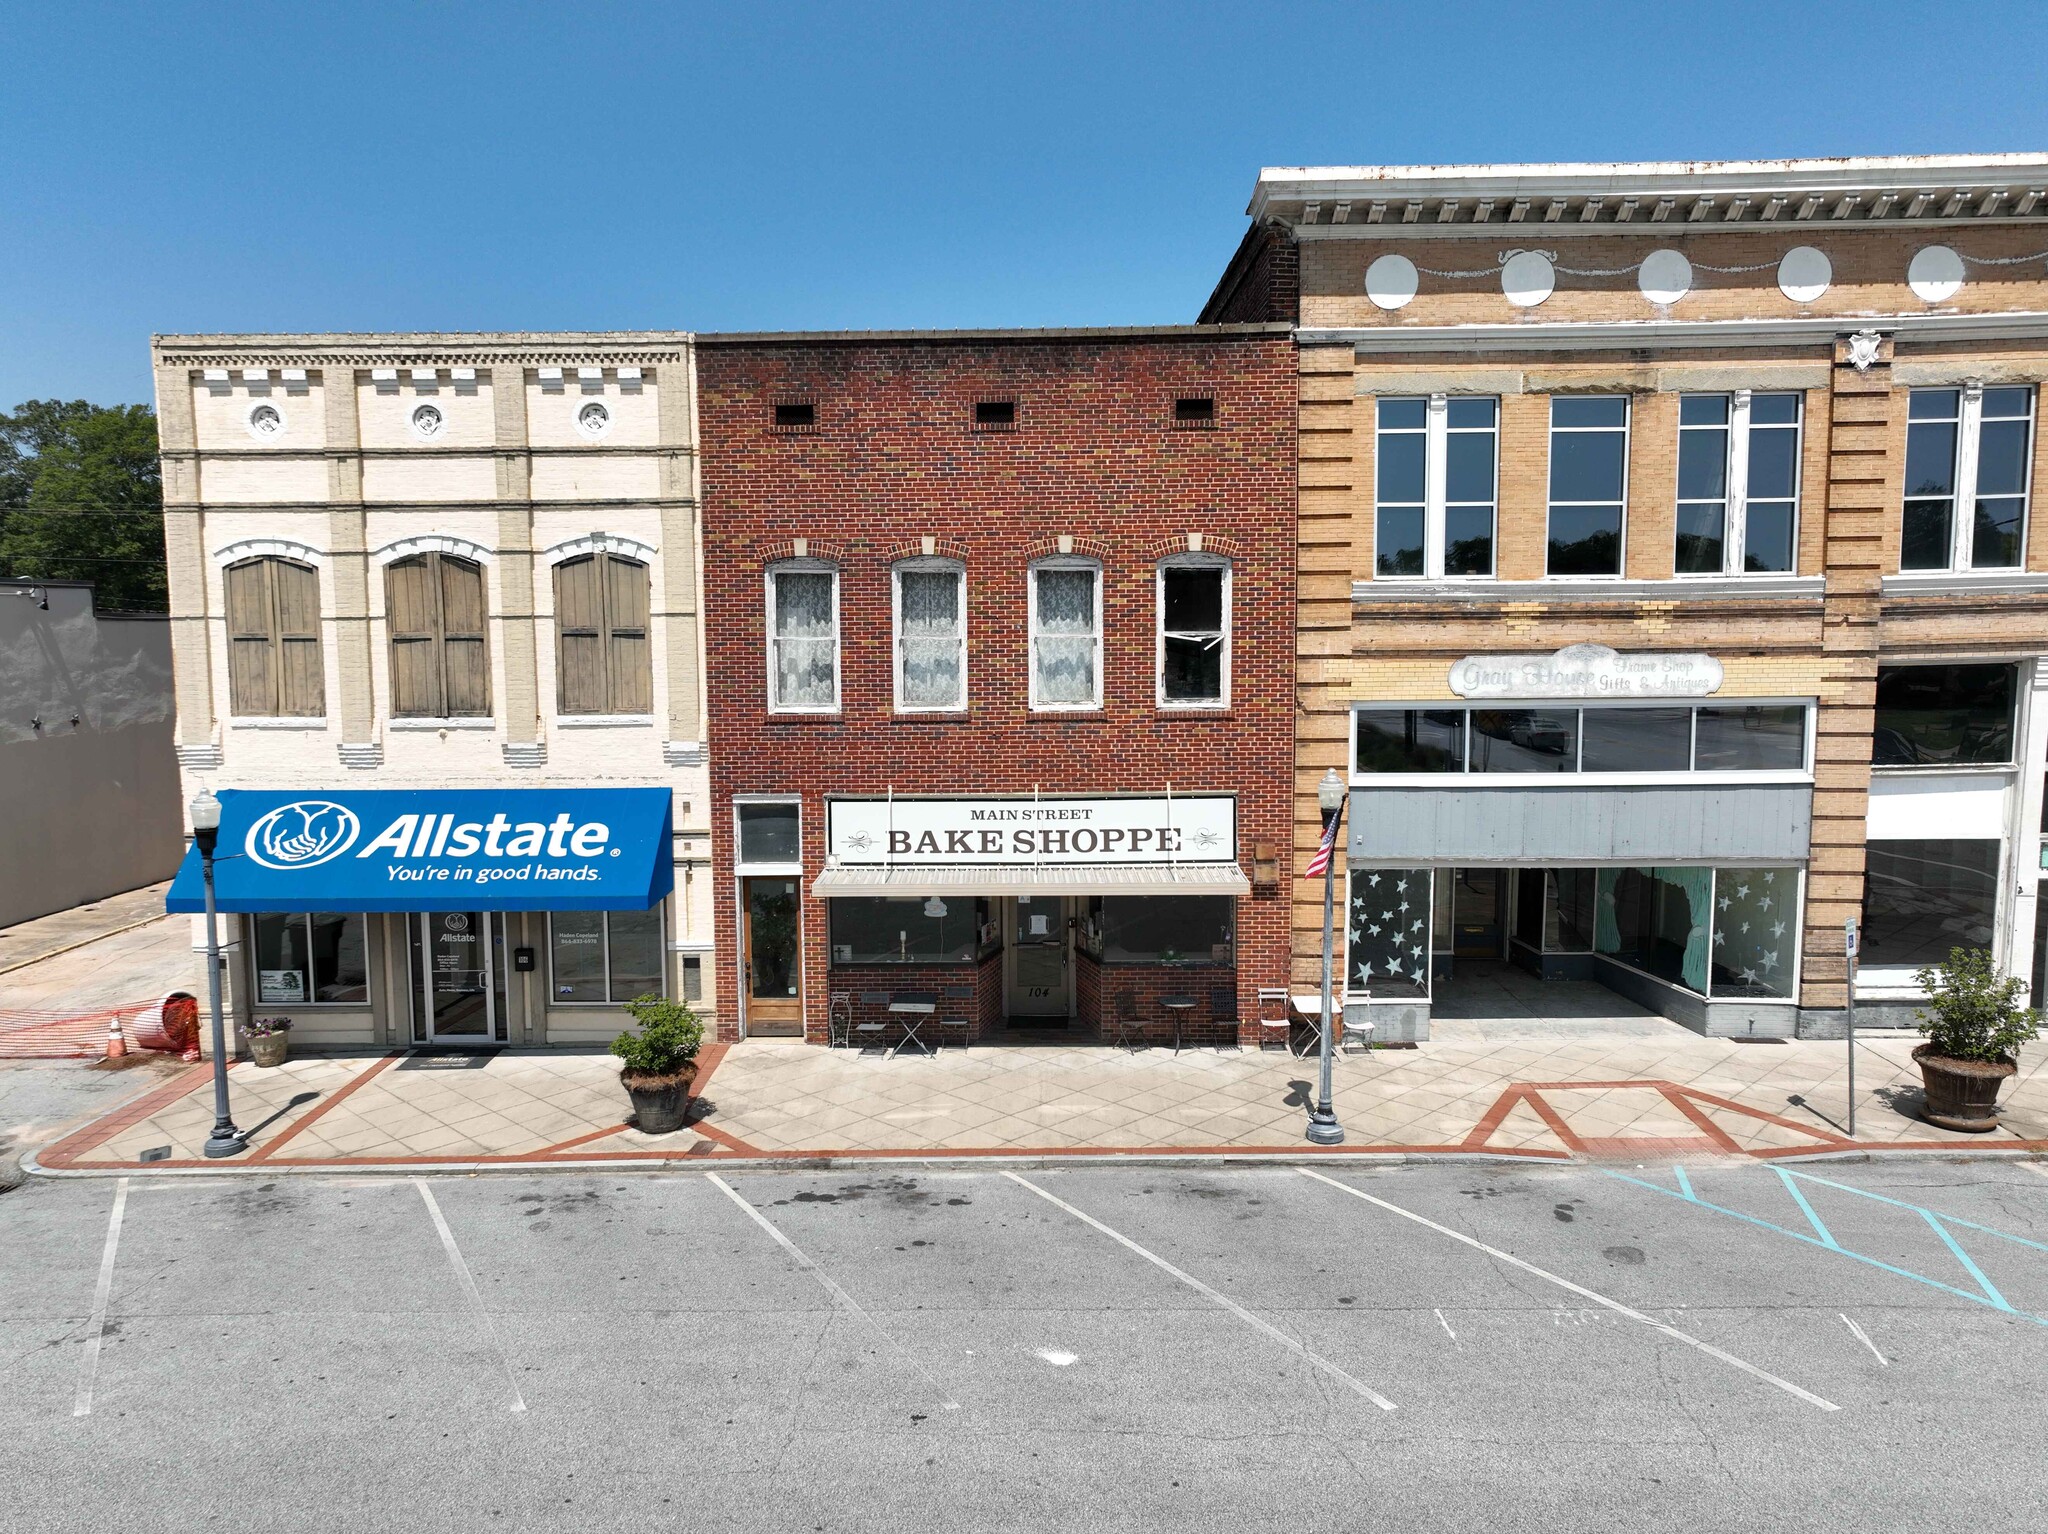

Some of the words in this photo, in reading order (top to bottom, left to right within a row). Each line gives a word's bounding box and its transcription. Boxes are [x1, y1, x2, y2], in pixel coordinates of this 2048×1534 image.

[1612, 657, 1656, 673] Frame
[1661, 657, 1694, 673] Shop
[1463, 663, 1513, 692] Gray
[1522, 663, 1596, 686] House
[1599, 674, 1631, 692] Gifts
[1640, 677, 1650, 689] &
[1654, 674, 1710, 691] Antiques
[970, 809, 1019, 821] MAIN
[1022, 808, 1093, 821] STREET
[886, 830, 1003, 854] BAKE
[1012, 828, 1182, 854] SHOPPE
[387, 865, 449, 882] You're
[453, 864, 472, 881] in
[475, 864, 529, 884] good
[534, 864, 602, 881] hands.
[439, 933, 476, 942] Allstate
[1028, 987, 1050, 998] 104
